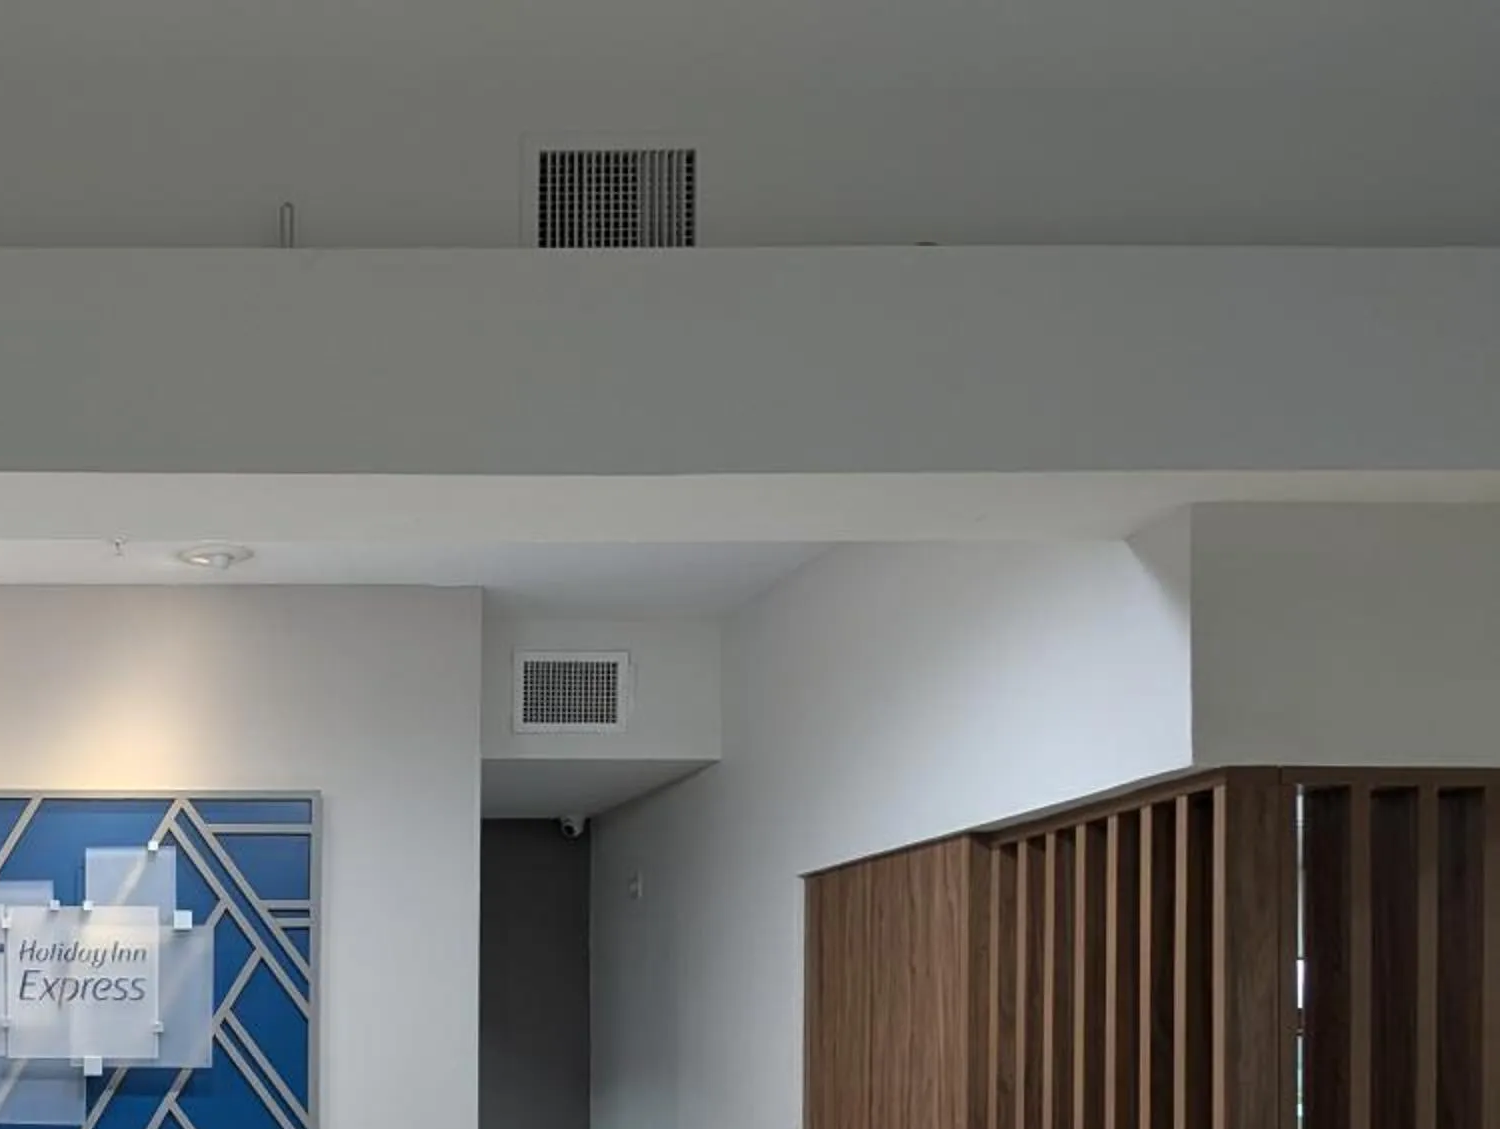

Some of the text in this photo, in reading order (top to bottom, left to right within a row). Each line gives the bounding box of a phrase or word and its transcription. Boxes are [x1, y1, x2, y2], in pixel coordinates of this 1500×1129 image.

[19, 940, 147, 968] Holiday Inn
[19, 969, 147, 1010] Express
